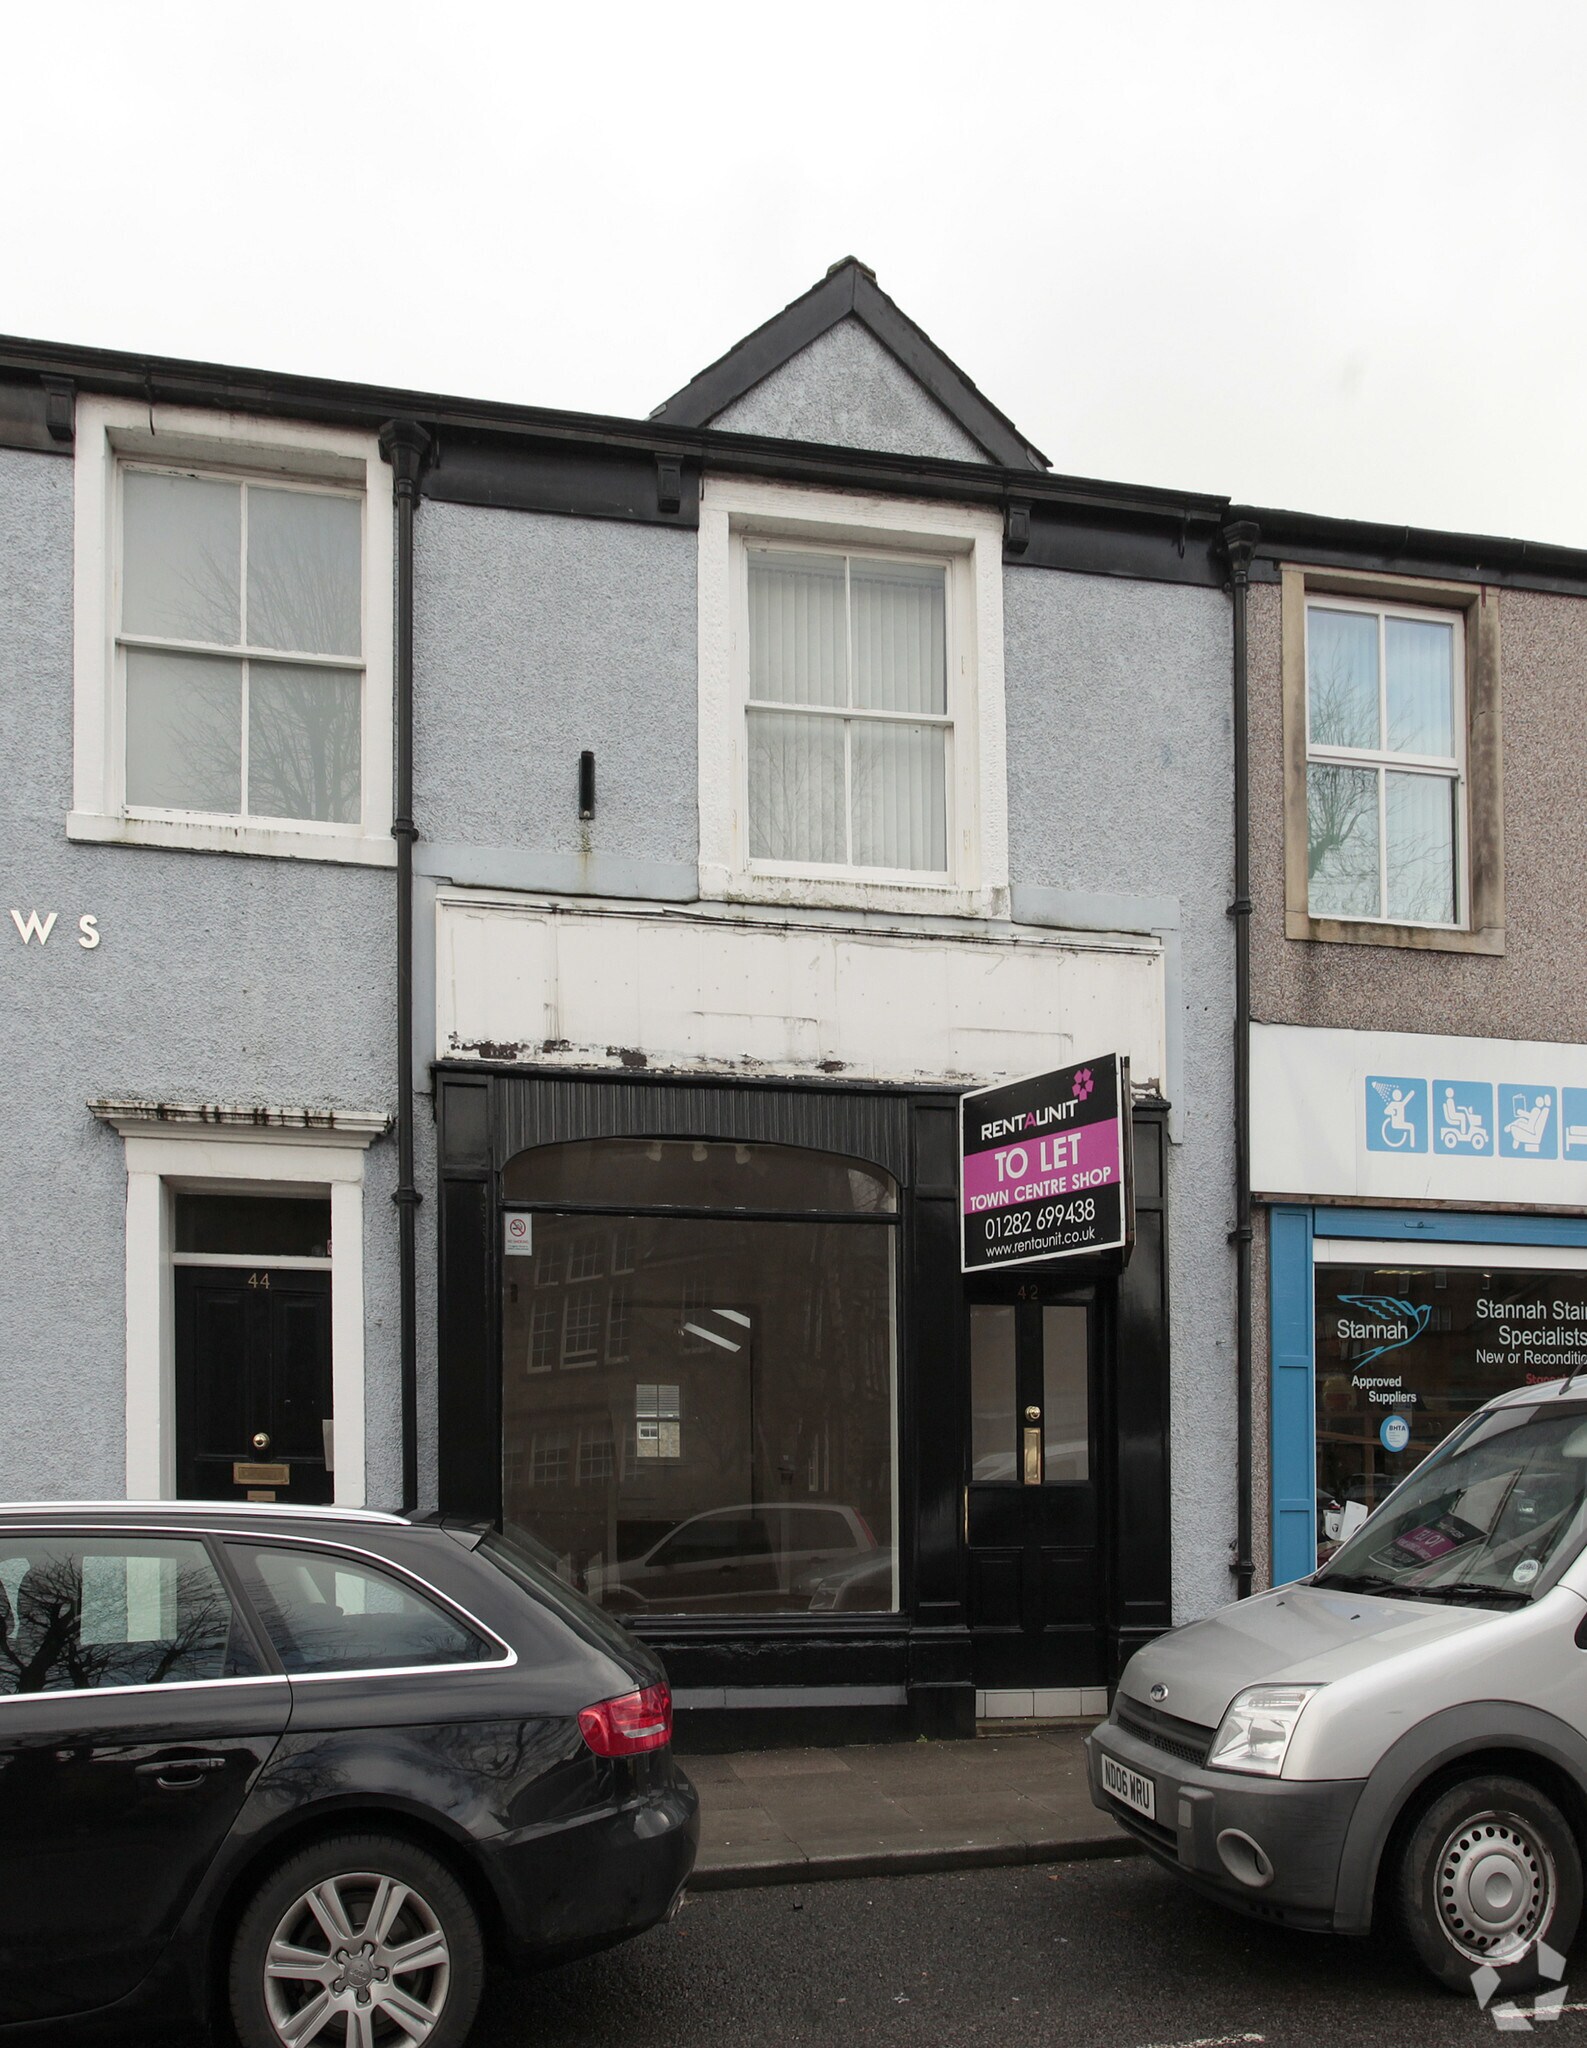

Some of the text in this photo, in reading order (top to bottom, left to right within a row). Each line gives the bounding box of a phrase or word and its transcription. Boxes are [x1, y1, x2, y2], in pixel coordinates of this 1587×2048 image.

[981, 1099, 1079, 1141] RENTAUNIT
[995, 1132, 1081, 1182] TO LET
[970, 1165, 1112, 1212] TOWN CENTRE SHOP
[985, 1197, 1096, 1240] 01282 699438
[985, 1225, 1095, 1258] www.rentaunit.co.uk
[247, 1272, 270, 1289] 44
[1017, 1284, 1038, 1300] 42
[1476, 1298, 1547, 1319] Stannah
[1337, 1319, 1408, 1340] Stannah
[1498, 1325, 1587, 1350] Specialists
[1476, 1349, 1504, 1364] New
[1507, 1352, 1521, 1364] or
[1351, 1375, 1402, 1389] Approved
[1368, 1390, 1417, 1405] Suppliers
[1104, 1759, 1150, 1810] ND06 WRU
